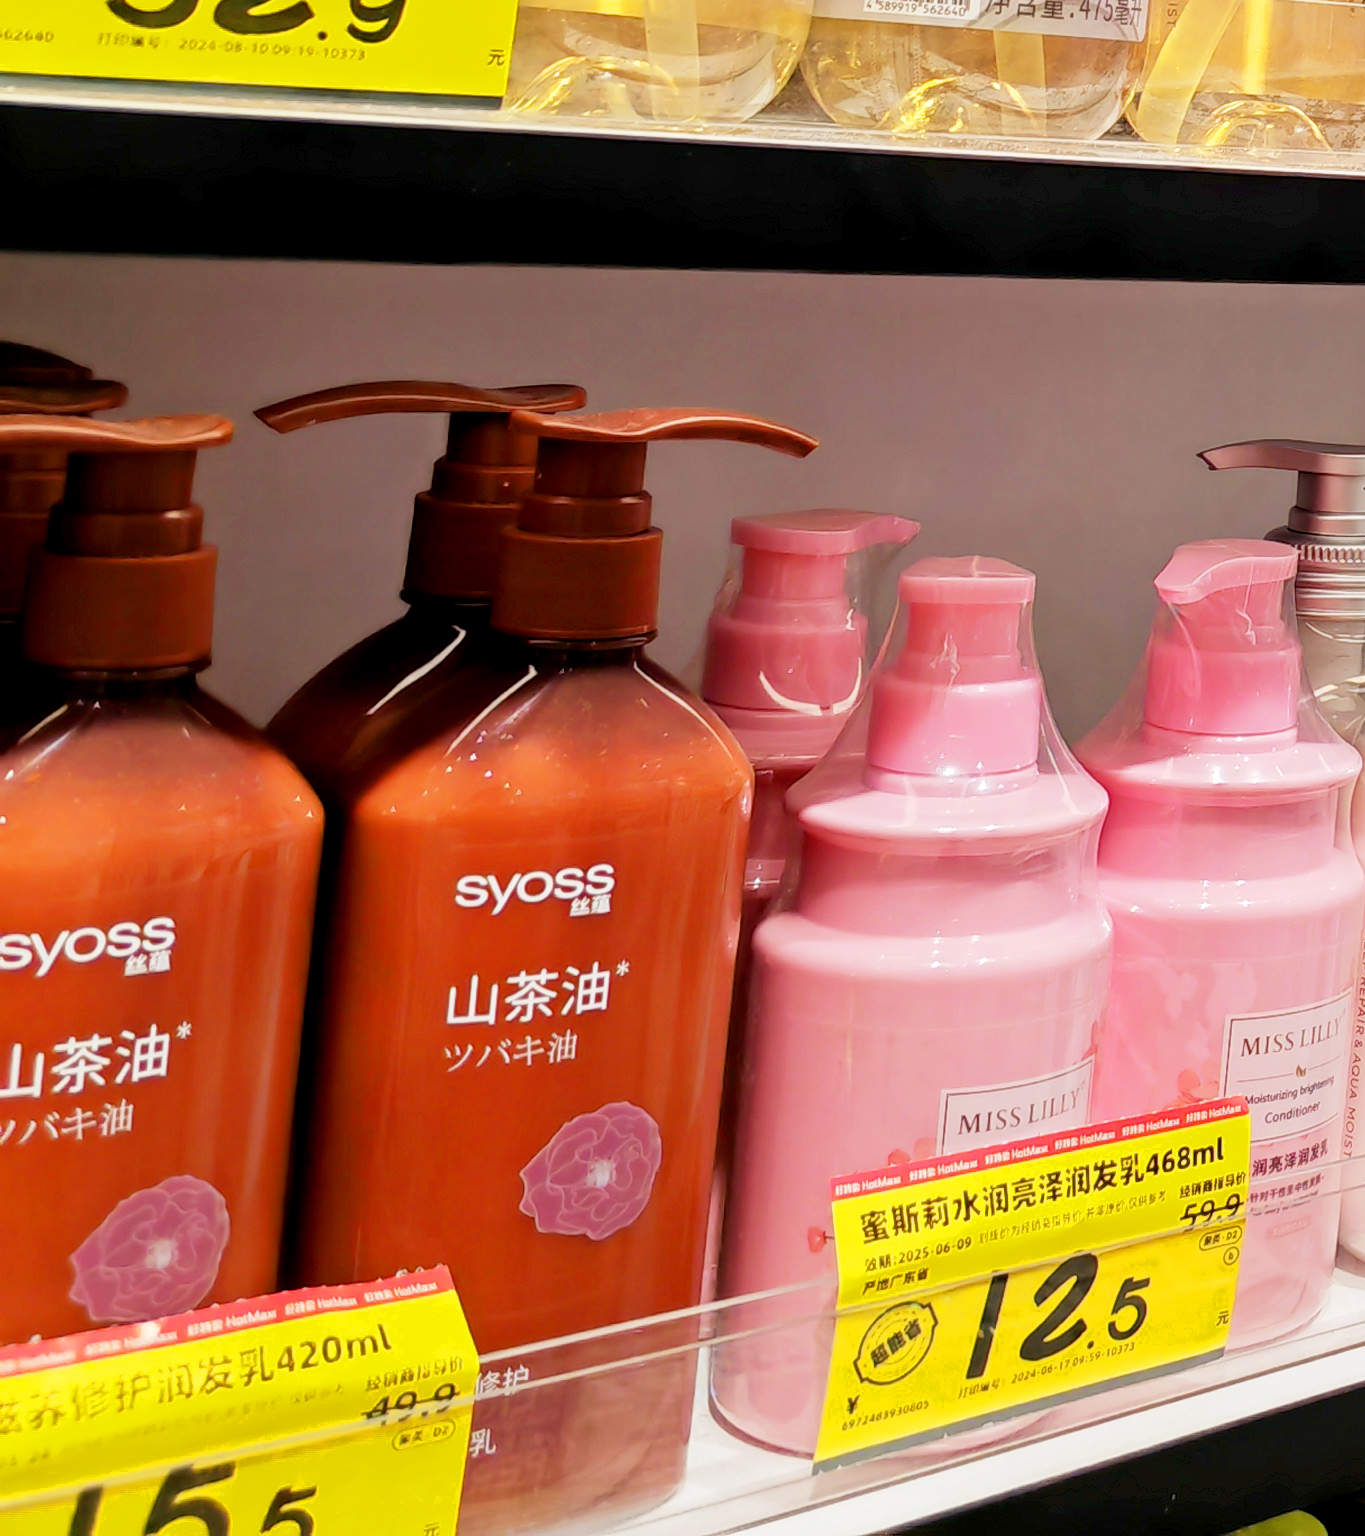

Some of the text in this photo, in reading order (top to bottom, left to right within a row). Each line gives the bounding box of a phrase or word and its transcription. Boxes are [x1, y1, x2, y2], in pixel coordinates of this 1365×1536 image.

[487, 51, 506, 67] 元
[454, 863, 616, 917] syoss
[568, 894, 612, 918] 丝蕴
[0, 915, 176, 978] syoss
[446, 960, 612, 1026] 山茶油
[443, 1028, 579, 1074] ツバキ油
[1240, 1017, 1345, 1057] MISS LILLY
[958, 1090, 1081, 1136] MISS LILLY
[1264, 1101, 1321, 1125] Conditioner
[860, 1139, 1225, 1245] 蜜斯莉水润亮泽润发乳468ml
[965, 1252, 1151, 1380] 12.5
[469, 1428, 497, 1458] 乳
